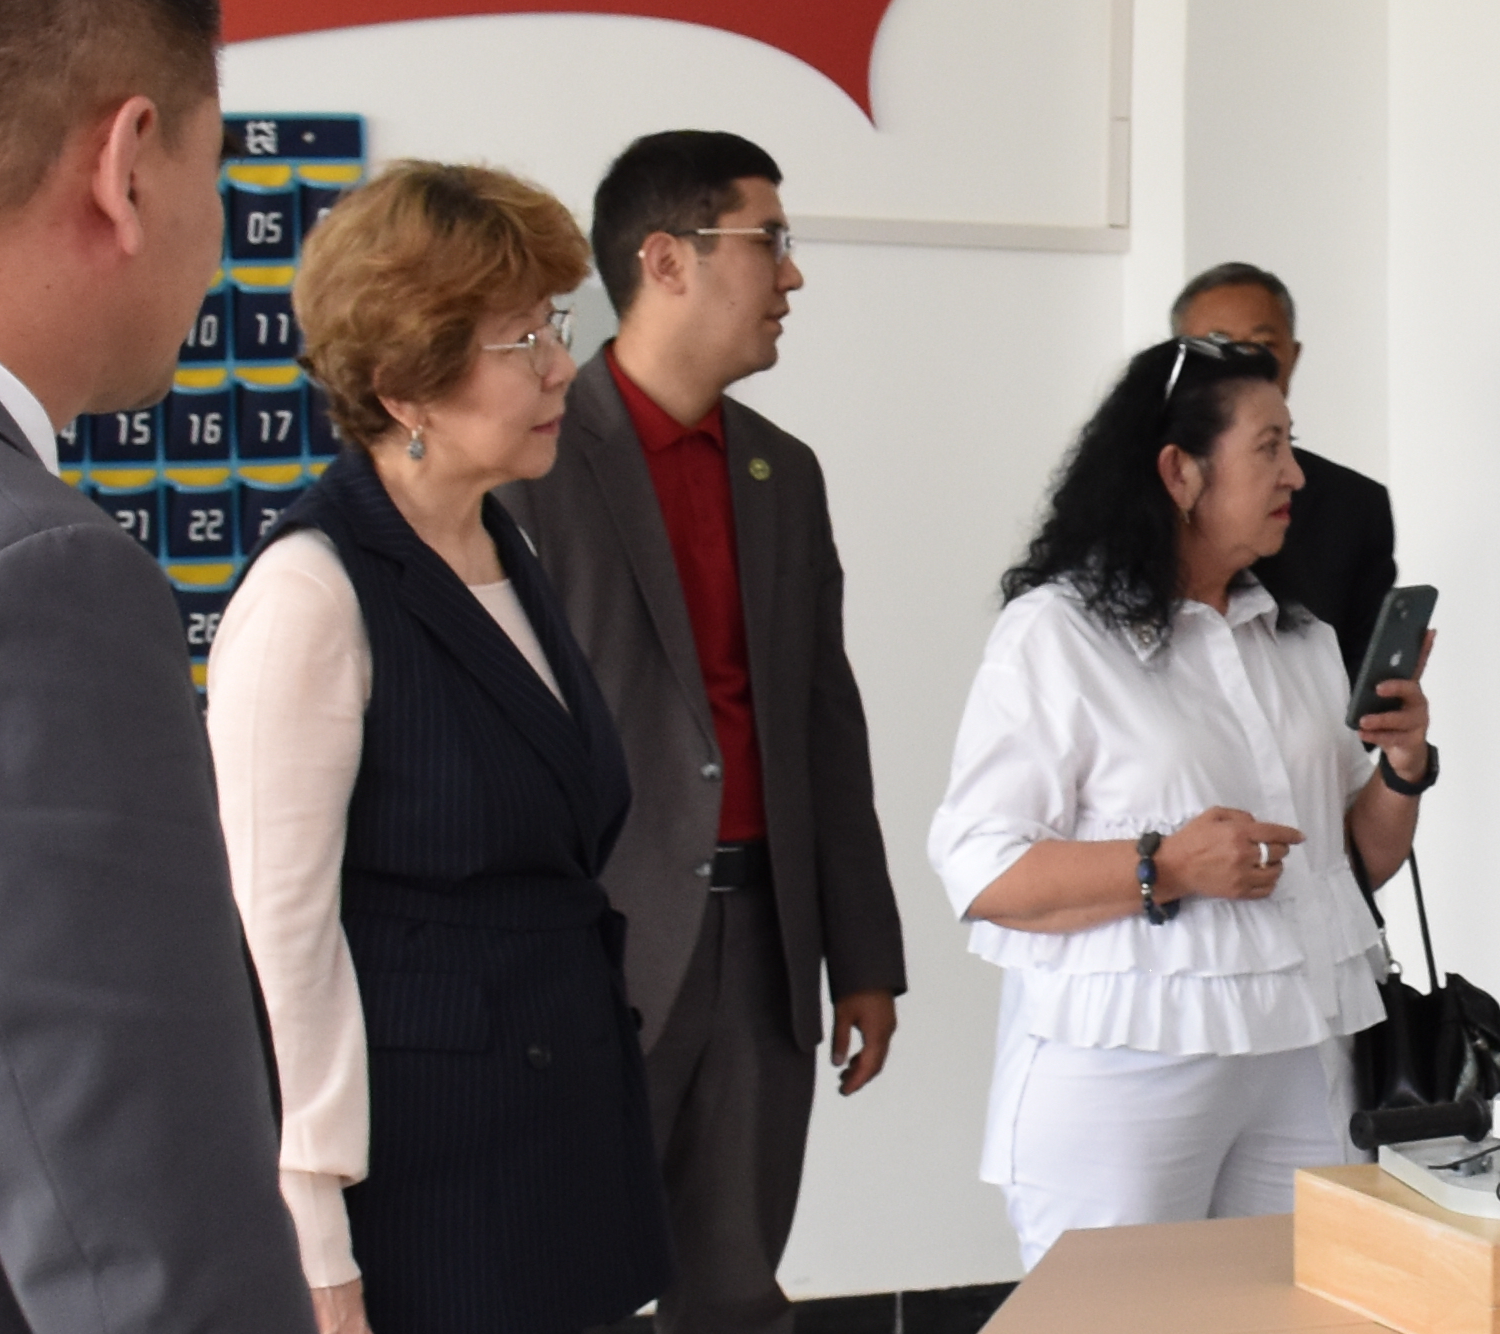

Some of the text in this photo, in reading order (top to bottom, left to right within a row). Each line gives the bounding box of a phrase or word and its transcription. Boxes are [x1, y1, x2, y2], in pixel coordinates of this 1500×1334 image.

[247, 212, 283, 244] 05
[255, 313, 290, 345] 11
[116, 412, 151, 445] 15
[189, 413, 222, 445] 16
[259, 410, 293, 443] 17
[188, 509, 224, 542] 22
[259, 508, 286, 536] 2
